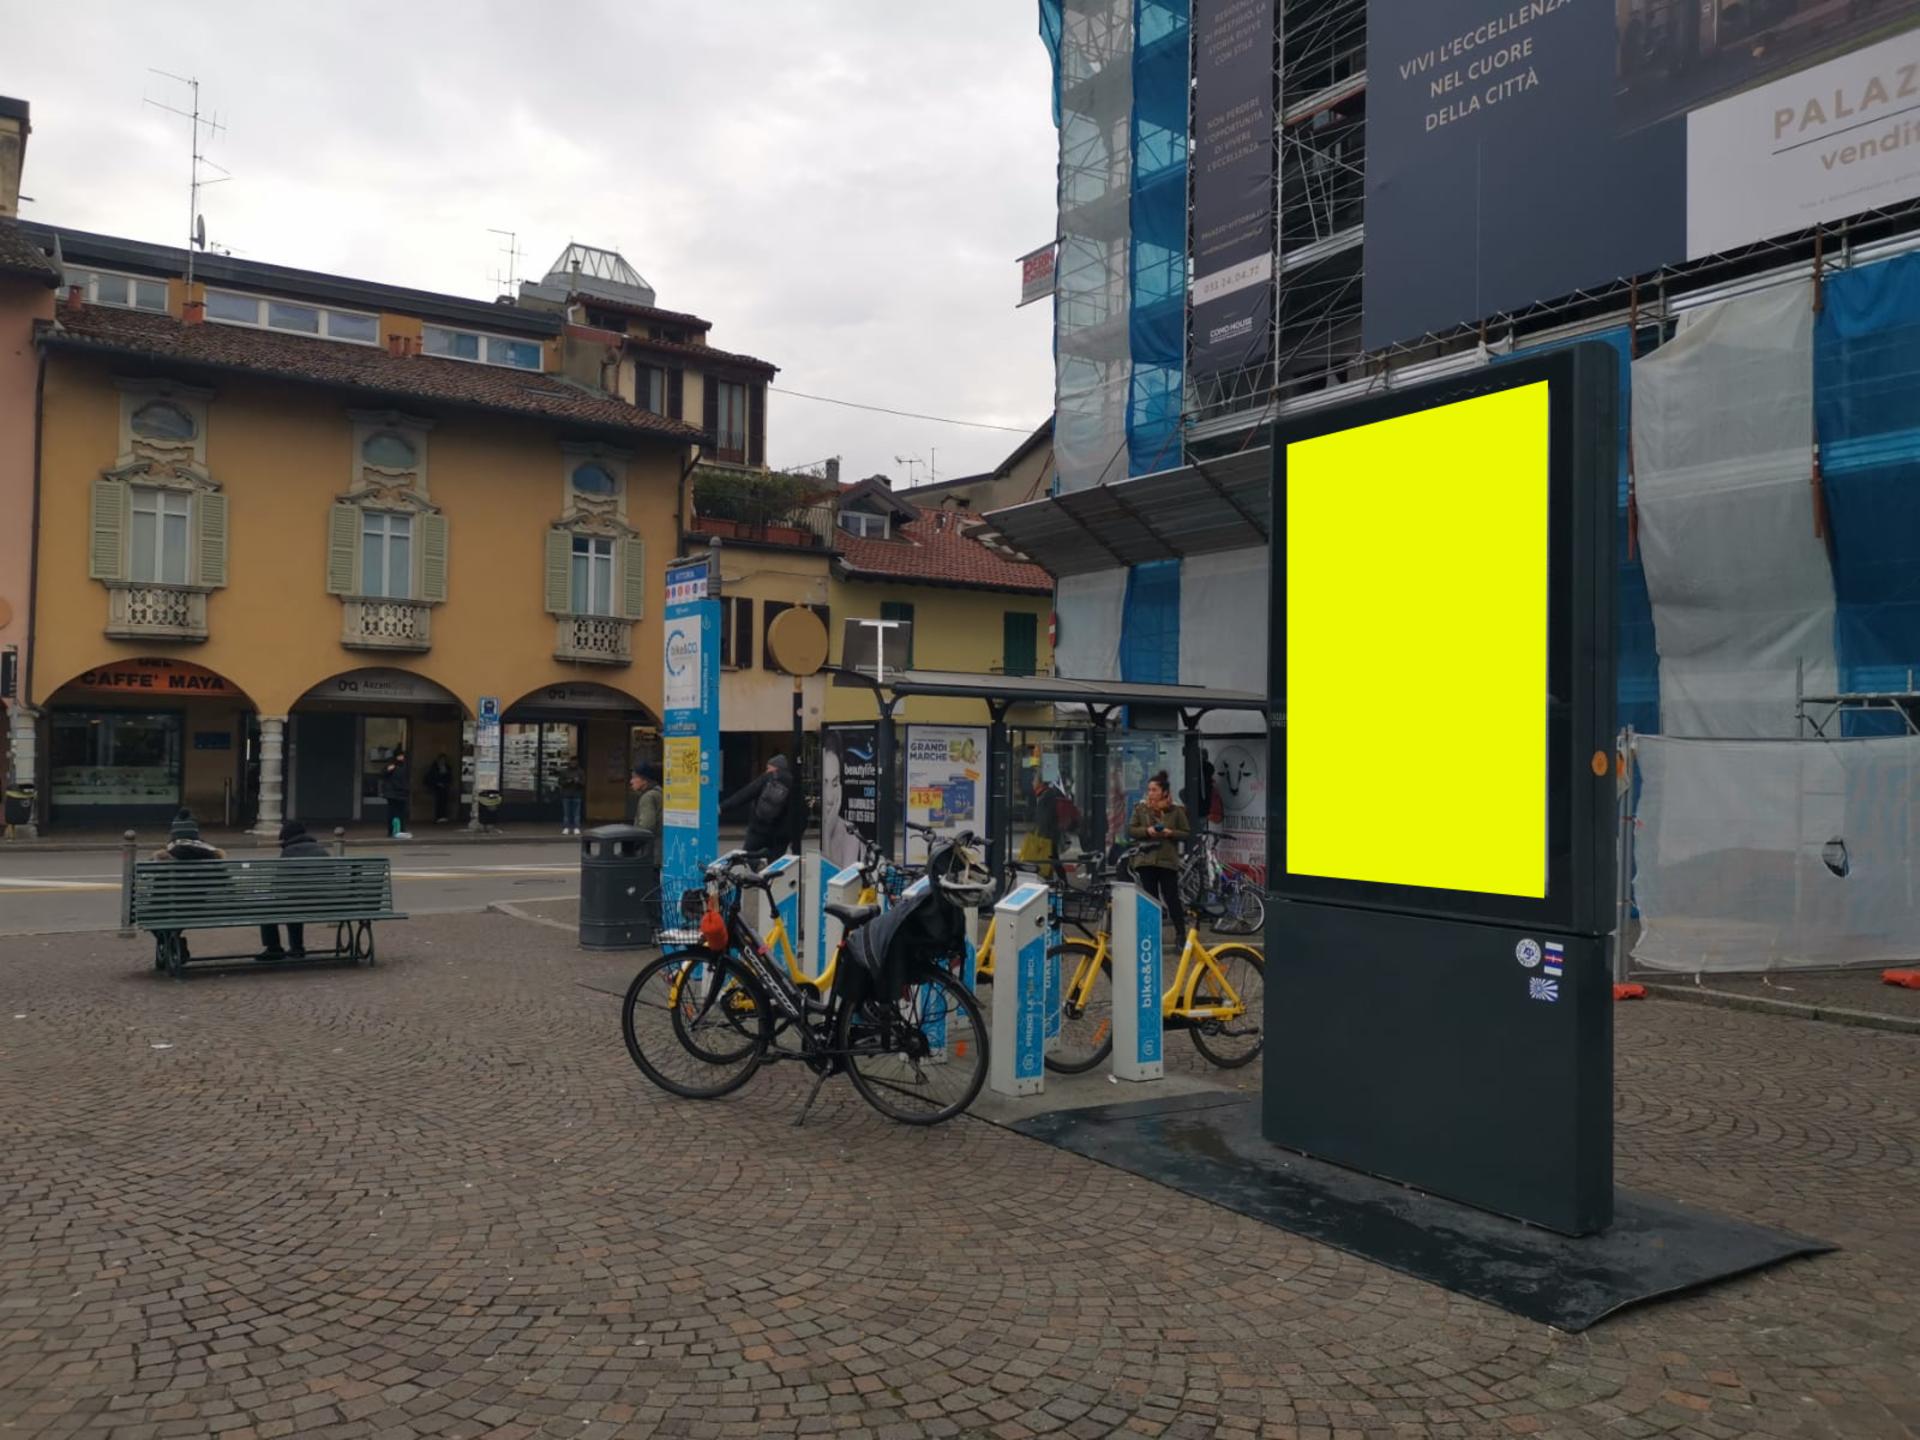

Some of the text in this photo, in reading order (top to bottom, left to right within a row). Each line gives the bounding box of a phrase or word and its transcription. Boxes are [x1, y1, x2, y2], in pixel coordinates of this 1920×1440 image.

[1399, 51, 1434, 81] VIVI
[1429, 38, 1533, 98] NEL CUORE
[1425, 67, 1539, 132] DELLA CITTÀ
[1774, 62, 1919, 140] PALAZ
[1207, 115, 1225, 130] NON
[82, 672, 225, 690] CAFFE' MAYA
[909, 752, 948, 762] MARCHE
[910, 742, 948, 752] GRANDI
[1140, 934, 1152, 1009] bike&CO.
